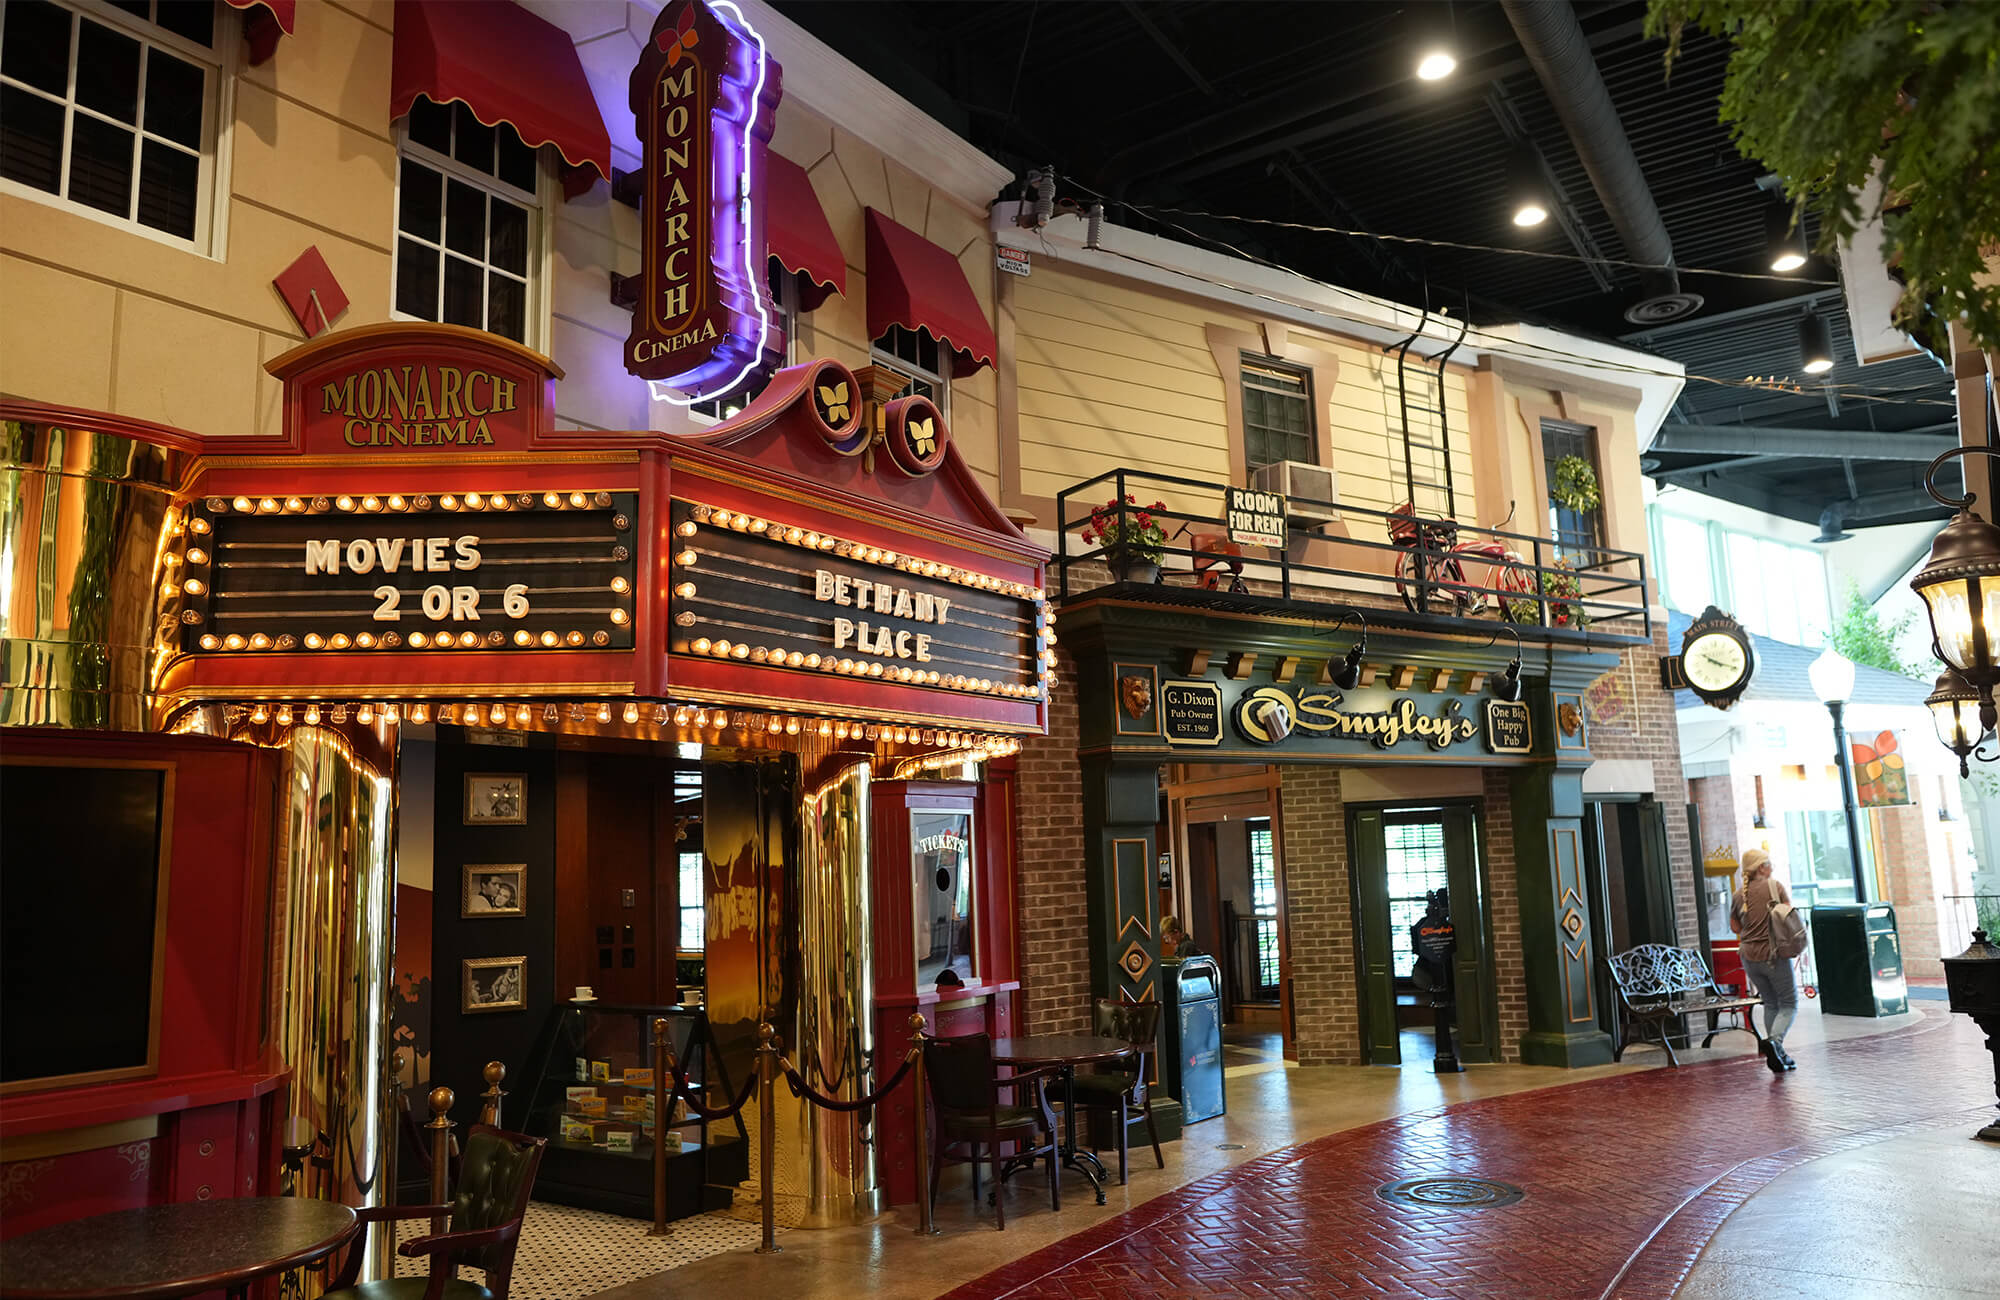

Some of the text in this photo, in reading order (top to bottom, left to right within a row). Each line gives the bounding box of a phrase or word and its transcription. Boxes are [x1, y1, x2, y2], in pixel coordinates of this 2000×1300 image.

[660, 65, 695, 320] MONARCH
[1000, 263, 1028, 274] VOLTAGE
[633, 318, 718, 363] CINEMA
[320, 365, 517, 420] MONARCH
[343, 417, 495, 446] CINEMA
[1233, 490, 1279, 514] ROOM
[1229, 510, 1285, 536] FOR RENT
[305, 535, 482, 575] MOVIES
[372, 583, 530, 621] 2 OR 6
[815, 569, 951, 625] BETHANY
[834, 617, 932, 662] PLACE
[1167, 691, 1215, 706] G. Dixon
[1171, 709, 1214, 719] Pub Owner
[1492, 706, 1526, 721] One Big
[1177, 723, 1209, 732] EST. 1960
[1497, 719, 1523, 734] Happy
[1503, 734, 1520, 746] Pub
[919, 834, 965, 854] TICKETS
